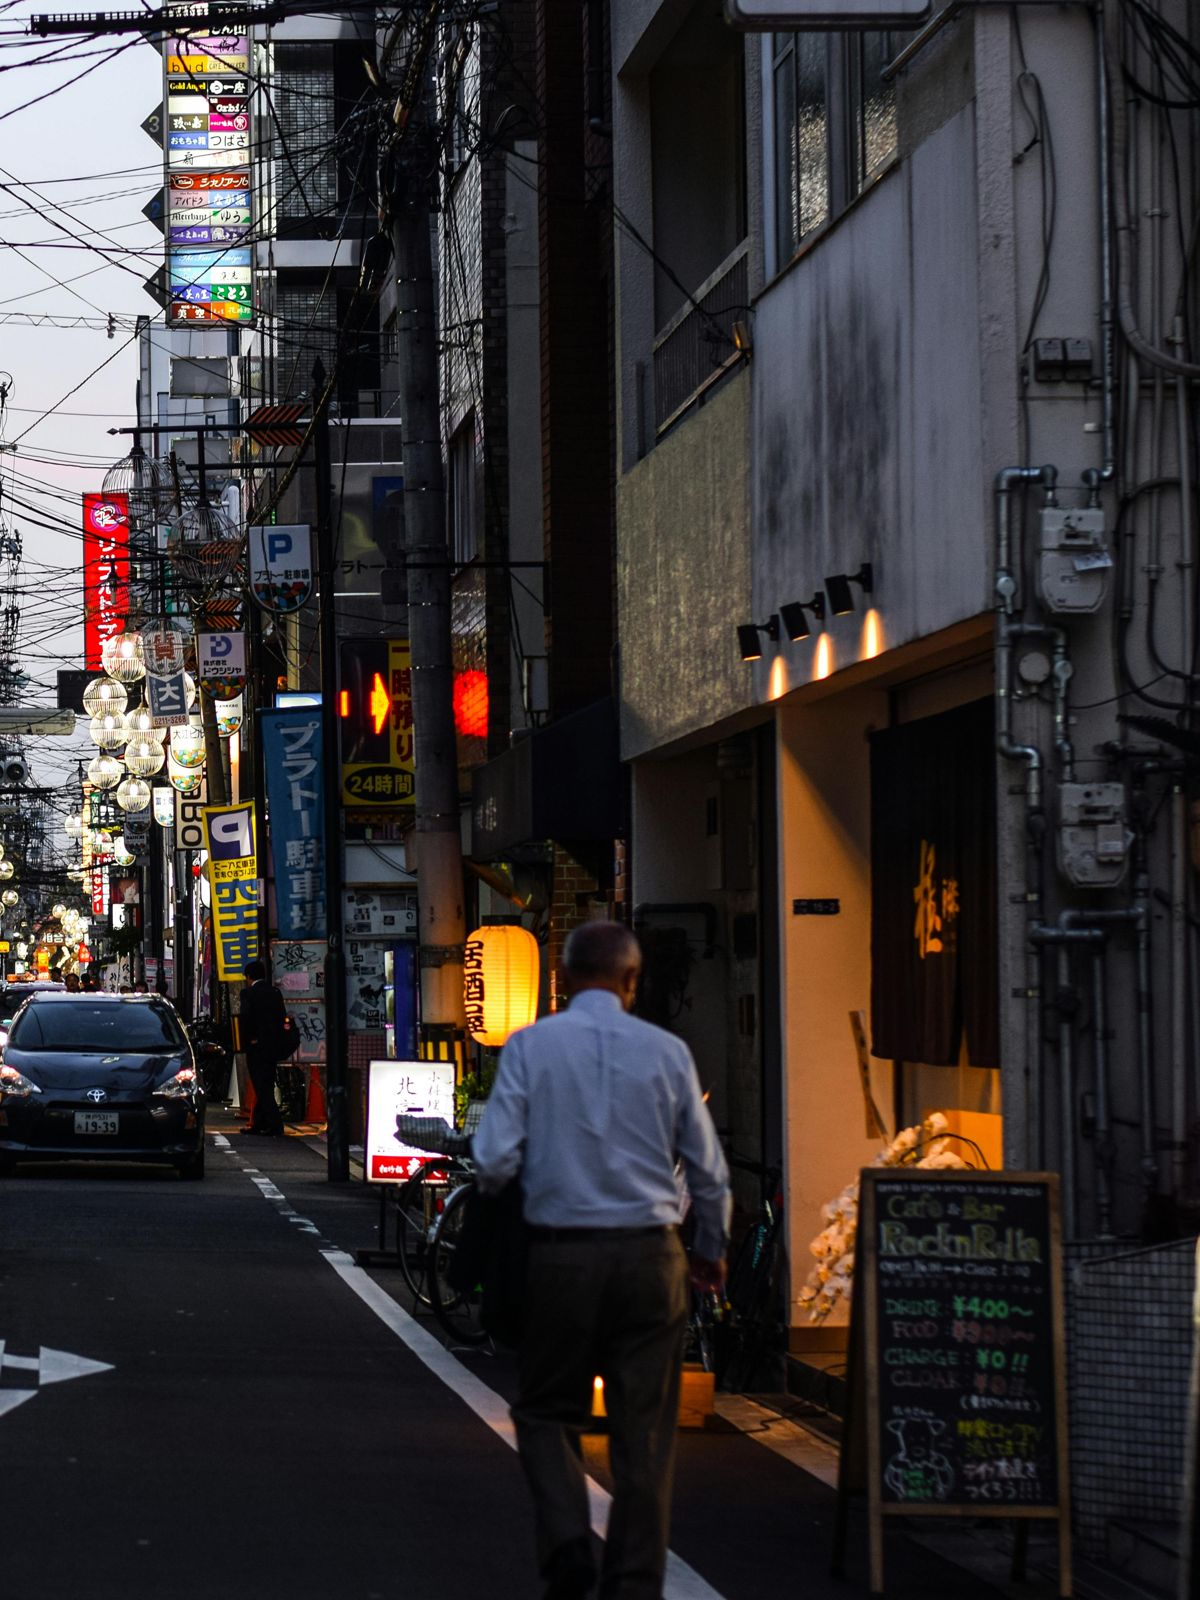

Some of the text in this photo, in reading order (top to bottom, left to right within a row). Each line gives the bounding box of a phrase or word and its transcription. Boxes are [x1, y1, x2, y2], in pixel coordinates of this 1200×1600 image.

[149, 115, 160, 133] 3
[210, 134, 247, 147] つばさ
[268, 533, 293, 563] P
[254, 569, 310, 582] プラトー駐車場
[203, 667, 242, 676] ドウシシャ
[350, 774, 414, 796] 24時間
[277, 720, 327, 932] プラトー駐車場
[85, 1121, 117, 1133] 19-39
[961, 1195, 1006, 1221] Bar
[884, 1348, 960, 1367] CHARGE
